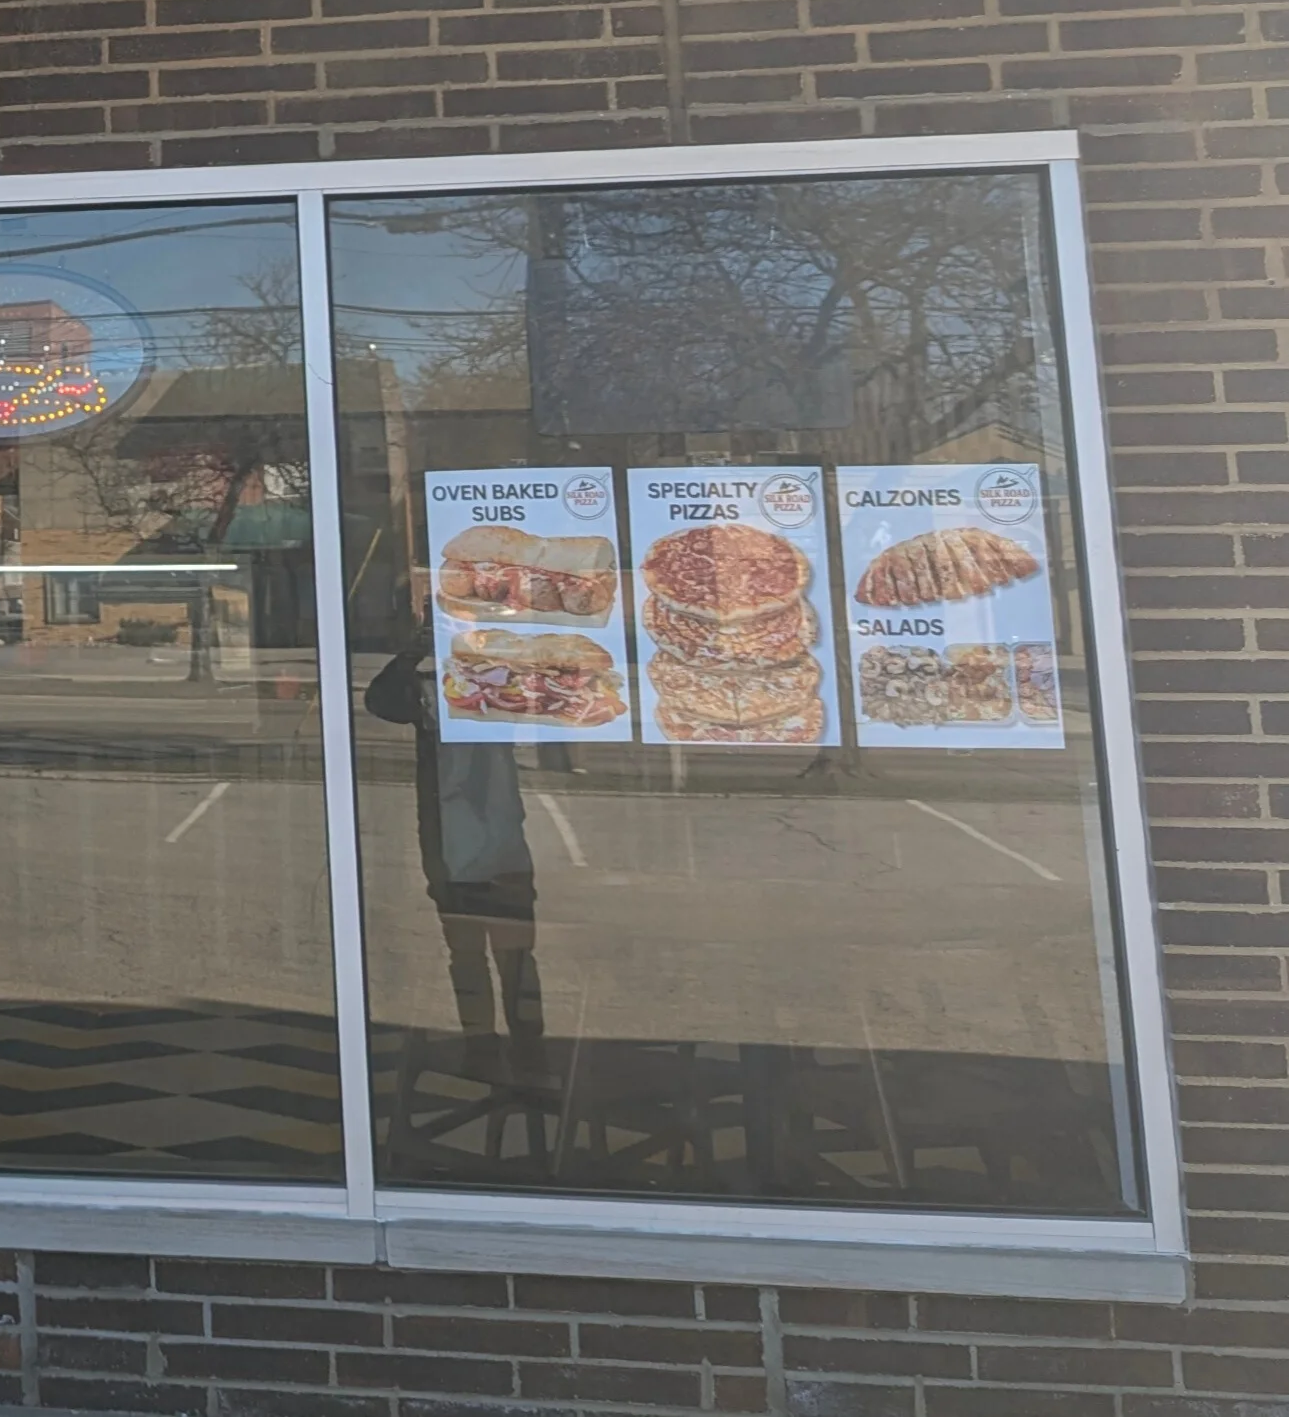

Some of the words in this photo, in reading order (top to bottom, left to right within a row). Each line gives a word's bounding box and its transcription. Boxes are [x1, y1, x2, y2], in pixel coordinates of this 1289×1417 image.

[431, 484, 487, 502] OVEN
[492, 483, 559, 500] BAKED
[647, 482, 757, 500] SPECIALTY
[764, 494, 785, 504] SILK
[786, 494, 811, 503] ROAD
[845, 489, 962, 508] CALZONES
[980, 489, 1001, 498] SILK
[1003, 489, 1030, 498] ROAD
[574, 498, 598, 506] PIZZA
[773, 503, 803, 512] PIZZA
[990, 498, 1021, 507] PIZZA
[472, 505, 526, 522] SUBS
[669, 504, 740, 520] PIZZAS
[857, 618, 944, 636] SALADS
